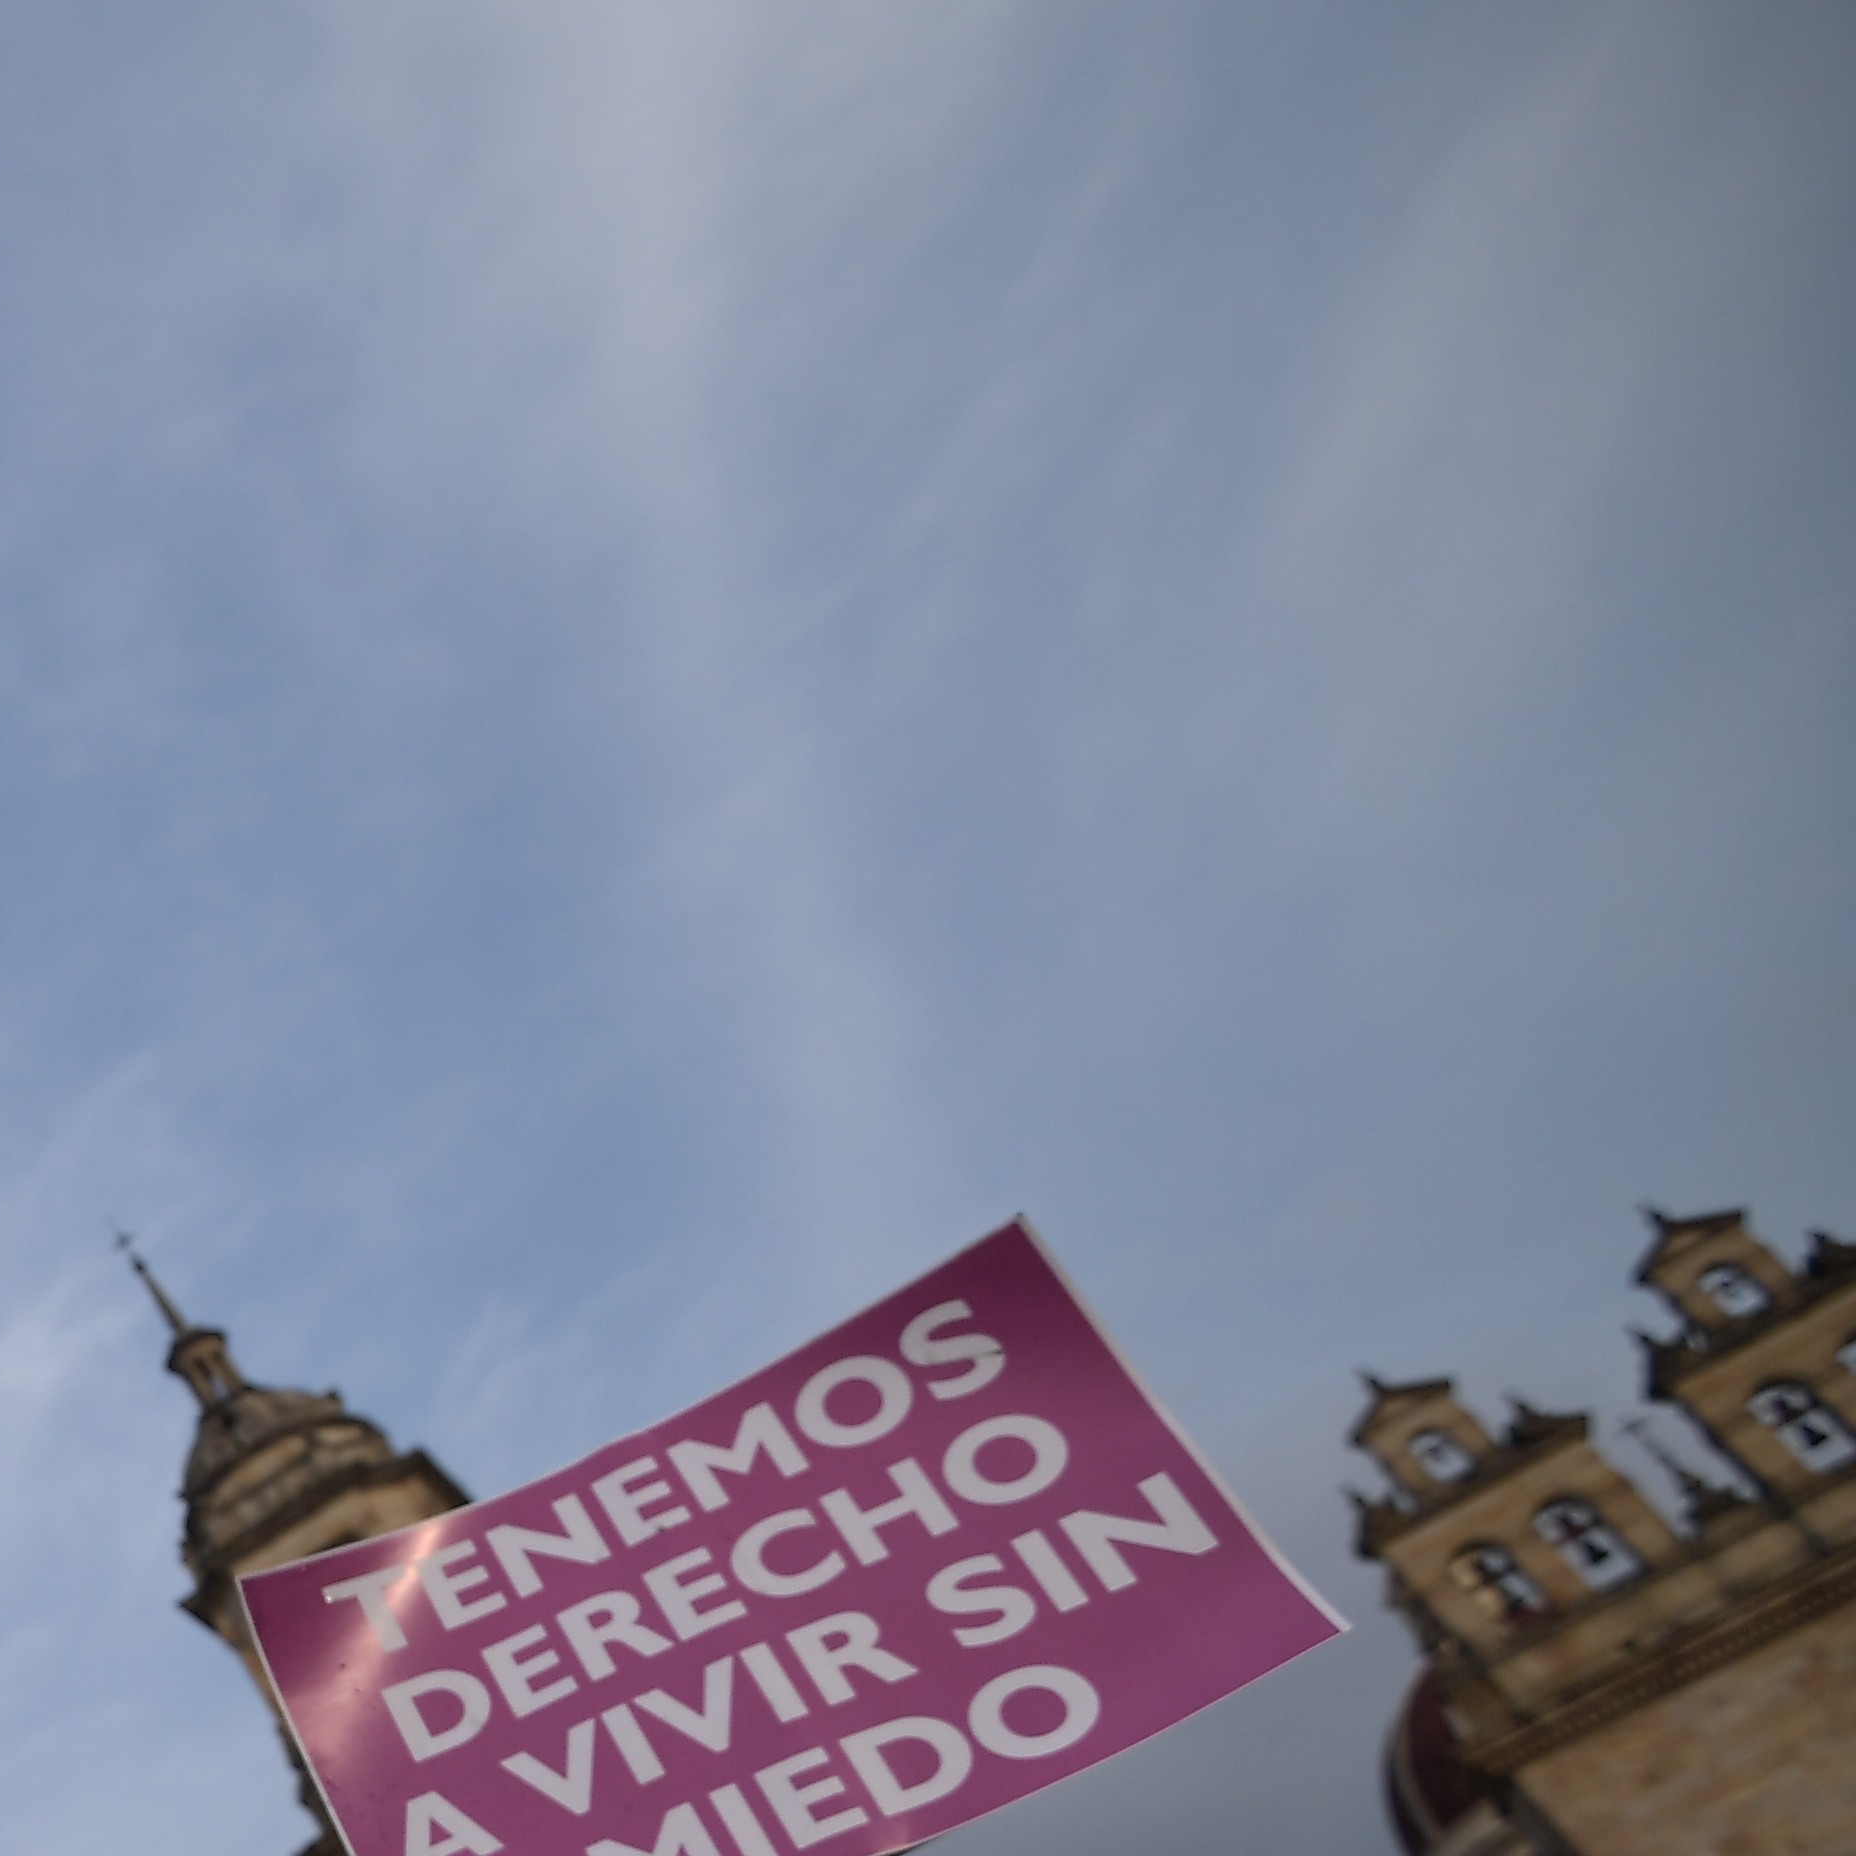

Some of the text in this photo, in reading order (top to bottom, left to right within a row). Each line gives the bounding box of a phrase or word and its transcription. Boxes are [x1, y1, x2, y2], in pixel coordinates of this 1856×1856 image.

[322, 1298, 1006, 1655] TENEMOS
[380, 1413, 1069, 1763] DERECHO
[501, 1611, 918, 1816] VIVIR
[926, 1472, 1219, 1648] SIN
